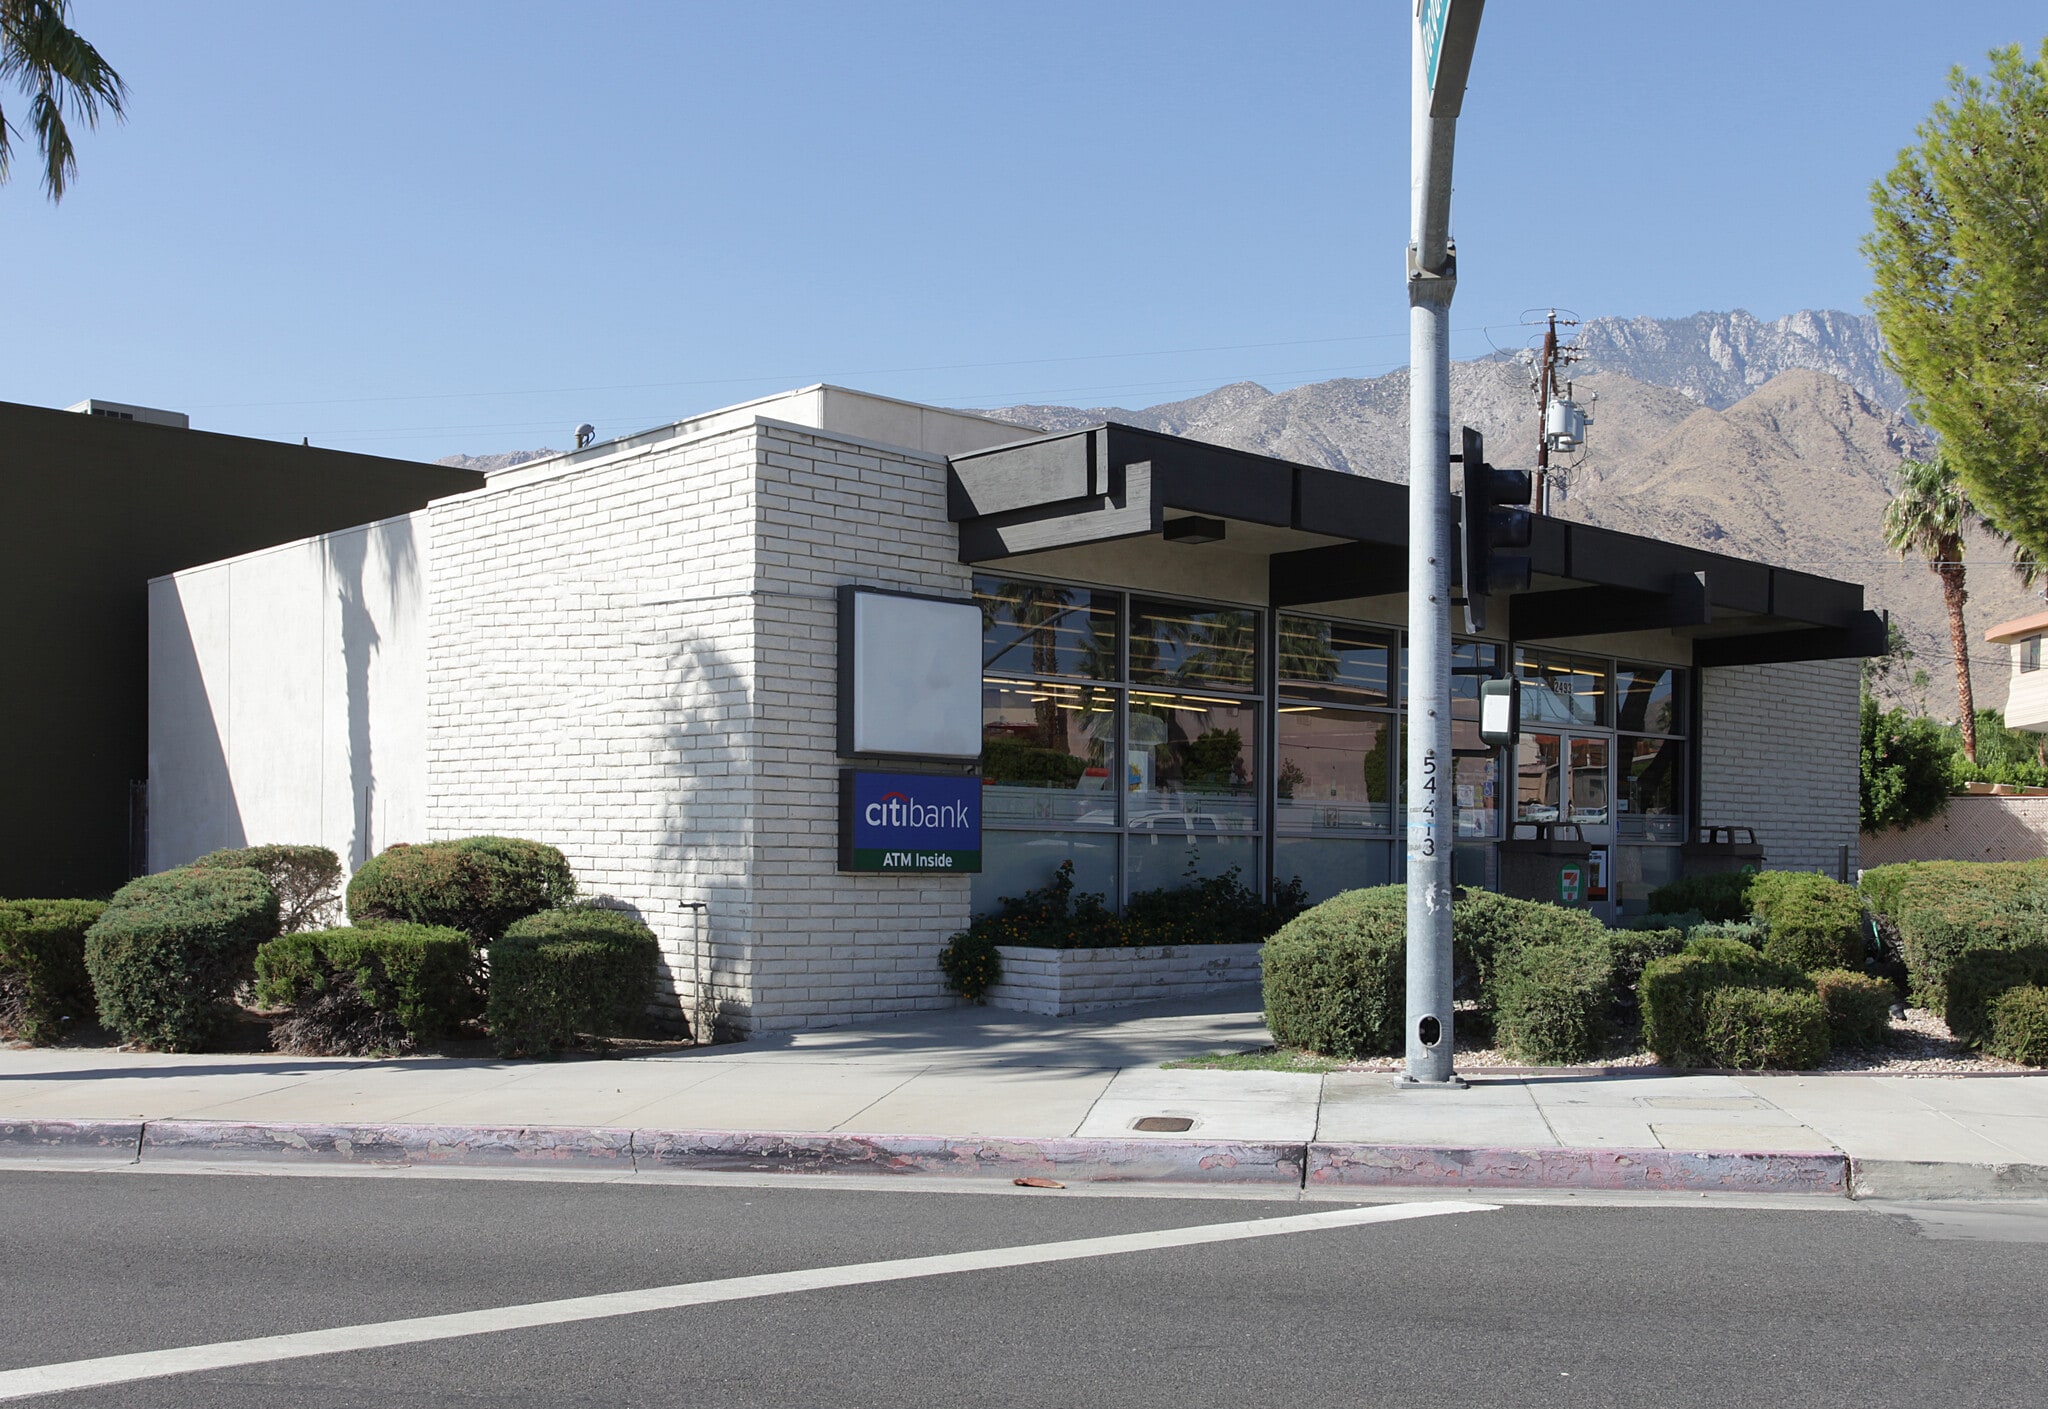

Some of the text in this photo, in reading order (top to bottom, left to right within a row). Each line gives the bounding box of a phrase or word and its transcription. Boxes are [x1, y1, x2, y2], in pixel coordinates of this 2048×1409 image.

[1554, 681, 1572, 694] 2493
[865, 796, 969, 828] citibank
[883, 853, 953, 868] ATM Inside
